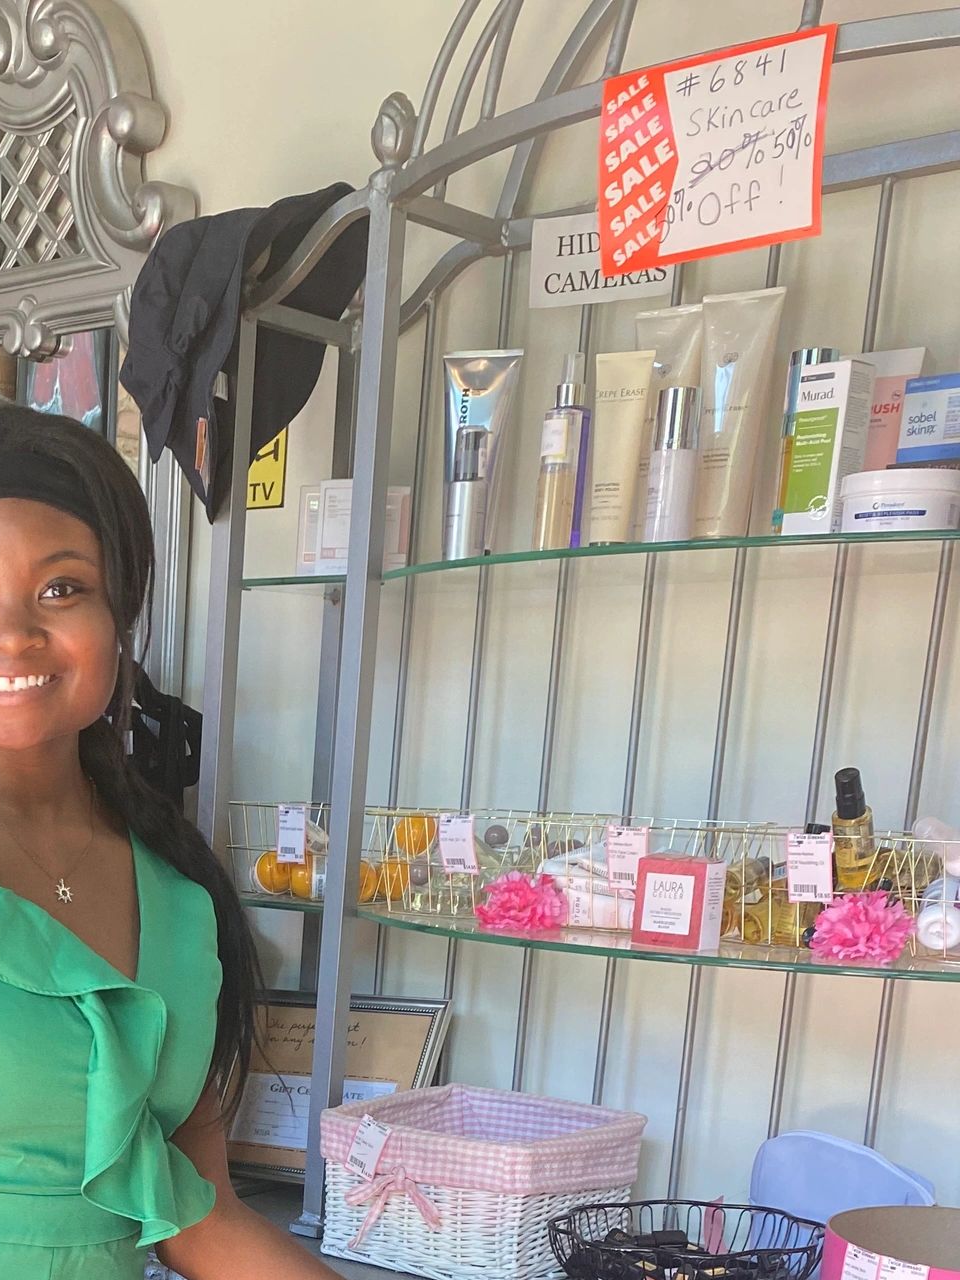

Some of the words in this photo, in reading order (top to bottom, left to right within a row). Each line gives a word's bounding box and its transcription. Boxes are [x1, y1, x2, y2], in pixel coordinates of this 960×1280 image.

[607, 75, 650, 115] SALE
[605, 93, 656, 142] SALE
[605, 115, 664, 173] SALE
[604, 138, 674, 207] SALE
[610, 181, 666, 237] SALE
[613, 216, 661, 267] SALE
[459, 388, 471, 426] ROTH
[801, 387, 834, 402] Murad
[871, 403, 901, 415] USH
[908, 411, 937, 424] sobel
[653, 880, 684, 893] LAURA
